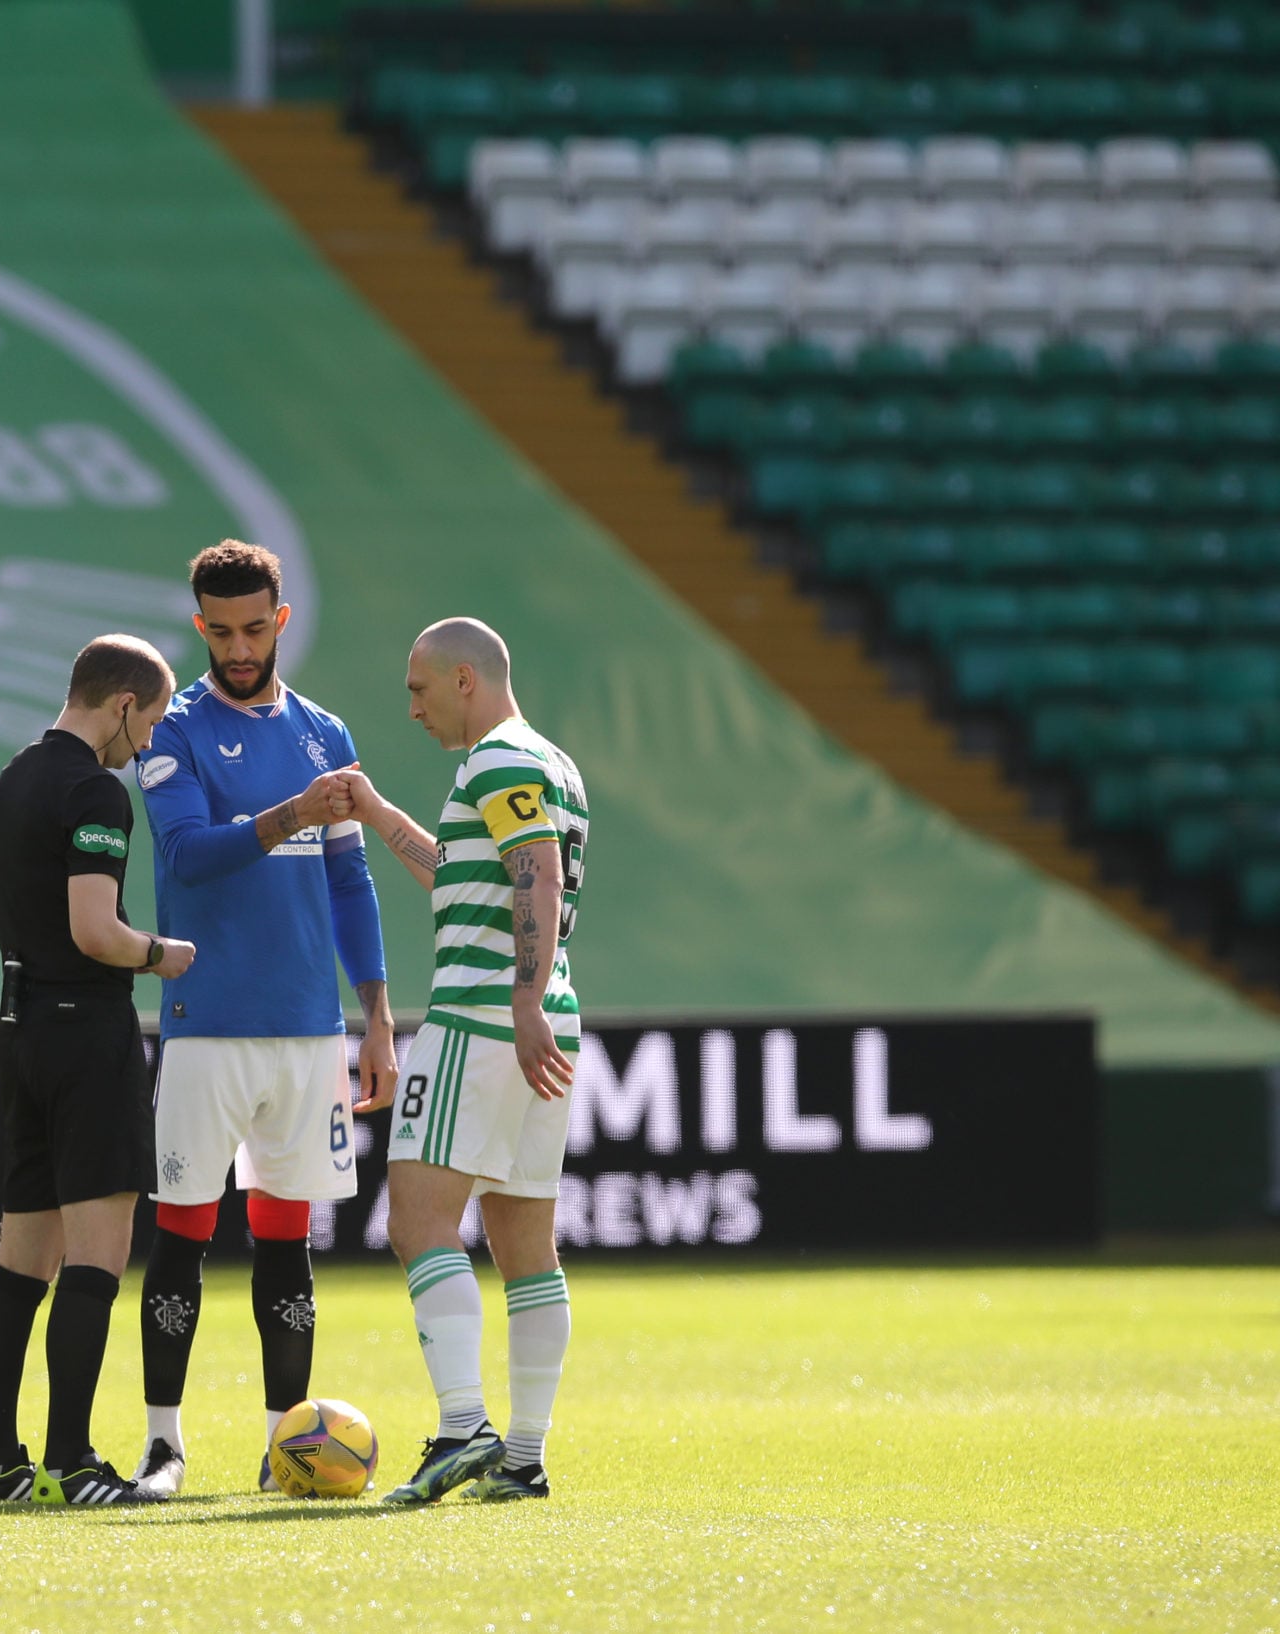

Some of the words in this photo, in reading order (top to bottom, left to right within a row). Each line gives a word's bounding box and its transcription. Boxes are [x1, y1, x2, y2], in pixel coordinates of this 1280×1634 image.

[507, 790, 538, 821] C
[401, 1075, 428, 1118] 8
[566, 1028, 933, 1155] MILL
[330, 1102, 349, 1152] 6
